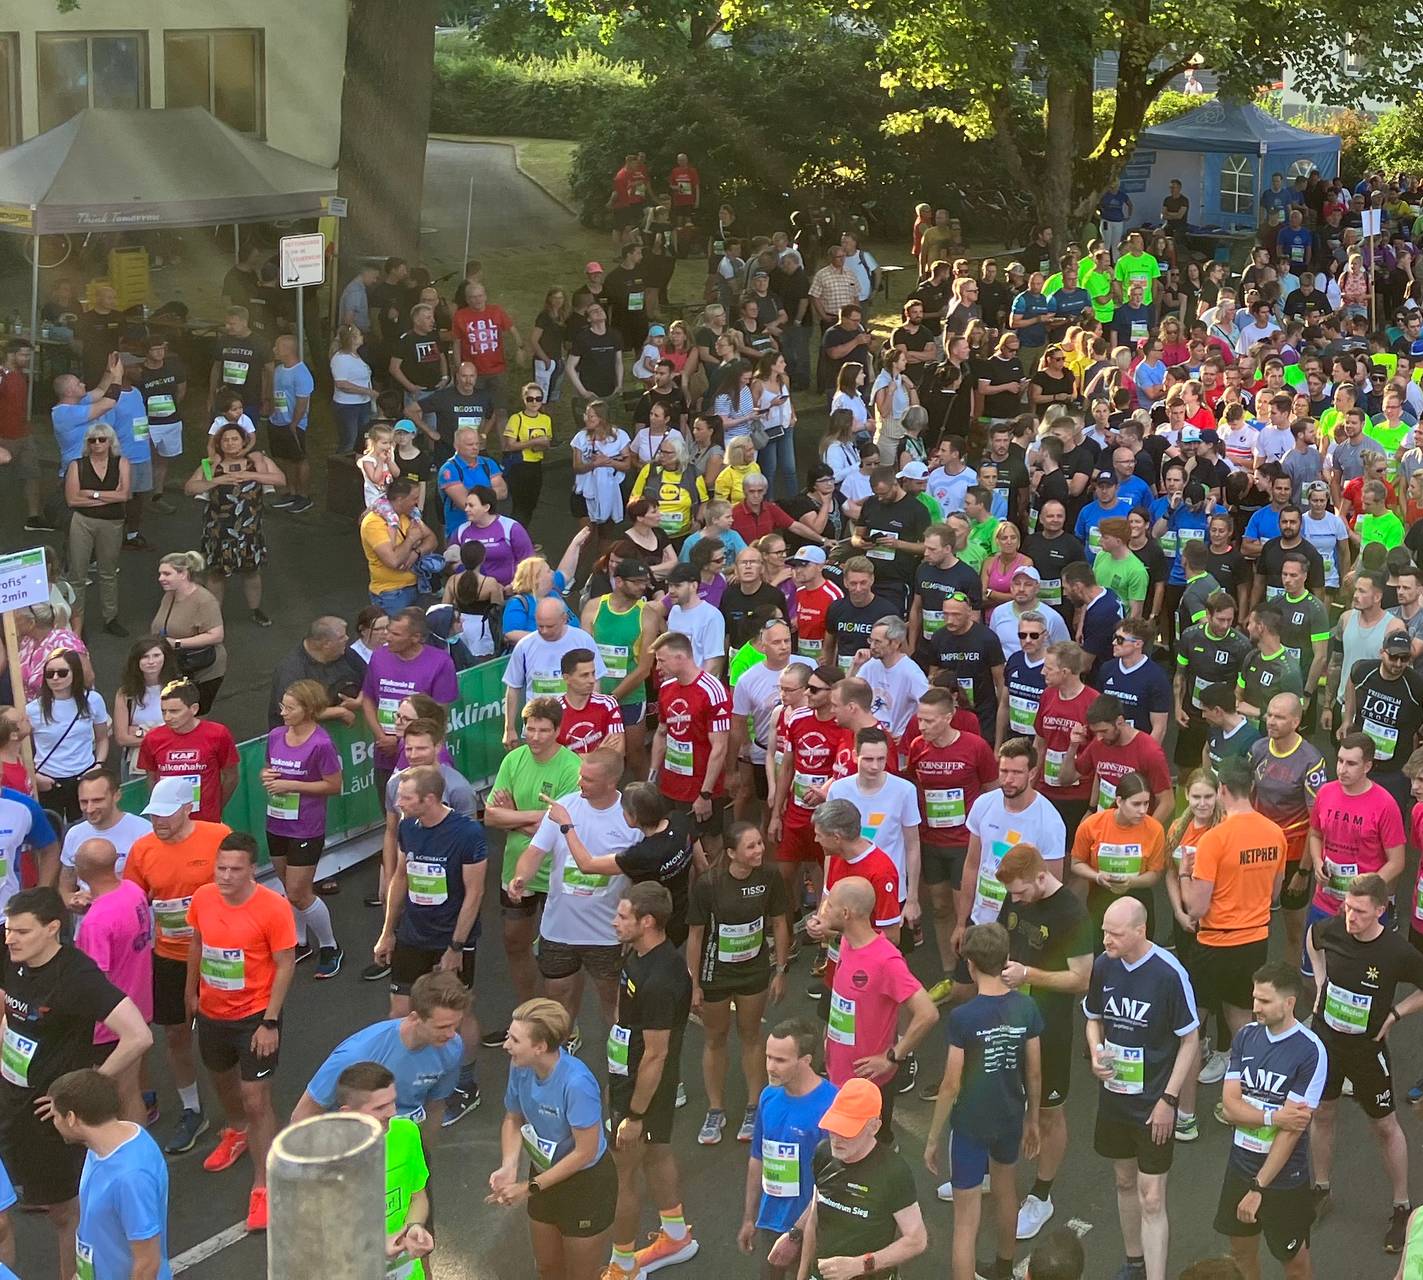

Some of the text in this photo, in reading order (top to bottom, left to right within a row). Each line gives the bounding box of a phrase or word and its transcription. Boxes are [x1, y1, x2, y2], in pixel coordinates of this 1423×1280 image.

[838, 622, 872, 634] PIONEE
[940, 652, 979, 661] IMPROVER
[1368, 689, 1402, 704] FRIEDHELM
[1362, 695, 1400, 720] LOH
[170, 751, 196, 761] KAF
[1327, 809, 1363, 825] TEAM
[1239, 846, 1278, 865] NETPHEN
[741, 885, 766, 896] TISSO
[1104, 996, 1152, 1023] AMZ
[1240, 1066, 1288, 1095] AMZ
[852, 1206, 869, 1218] Sieg
